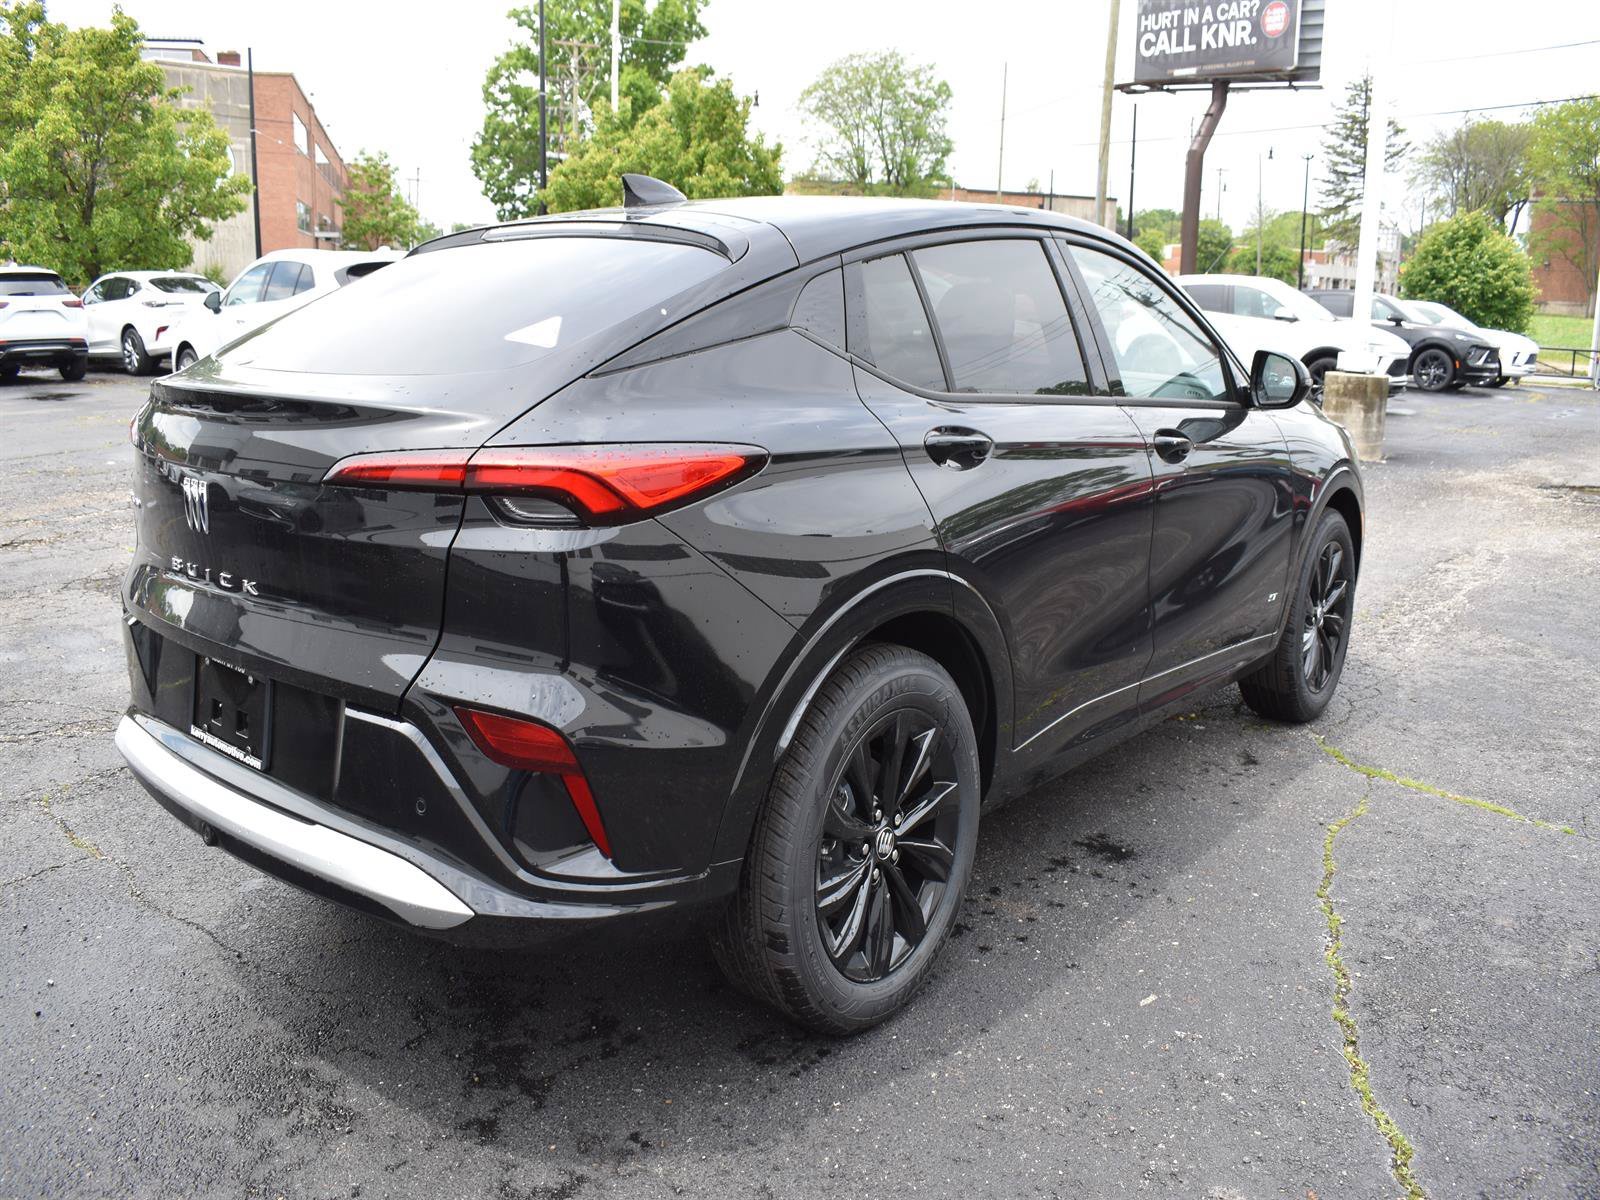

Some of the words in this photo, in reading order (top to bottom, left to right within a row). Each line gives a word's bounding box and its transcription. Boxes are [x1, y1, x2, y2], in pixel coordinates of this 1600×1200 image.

[1140, 9, 1181, 32] HURT
[1184, 7, 1200, 26] IN
[1201, 5, 1214, 23] A
[1216, 0, 1260, 21] CAR?
[1139, 27, 1197, 58] CALL
[1201, 20, 1258, 50] KNR.
[171, 556, 259, 595] BUICK
